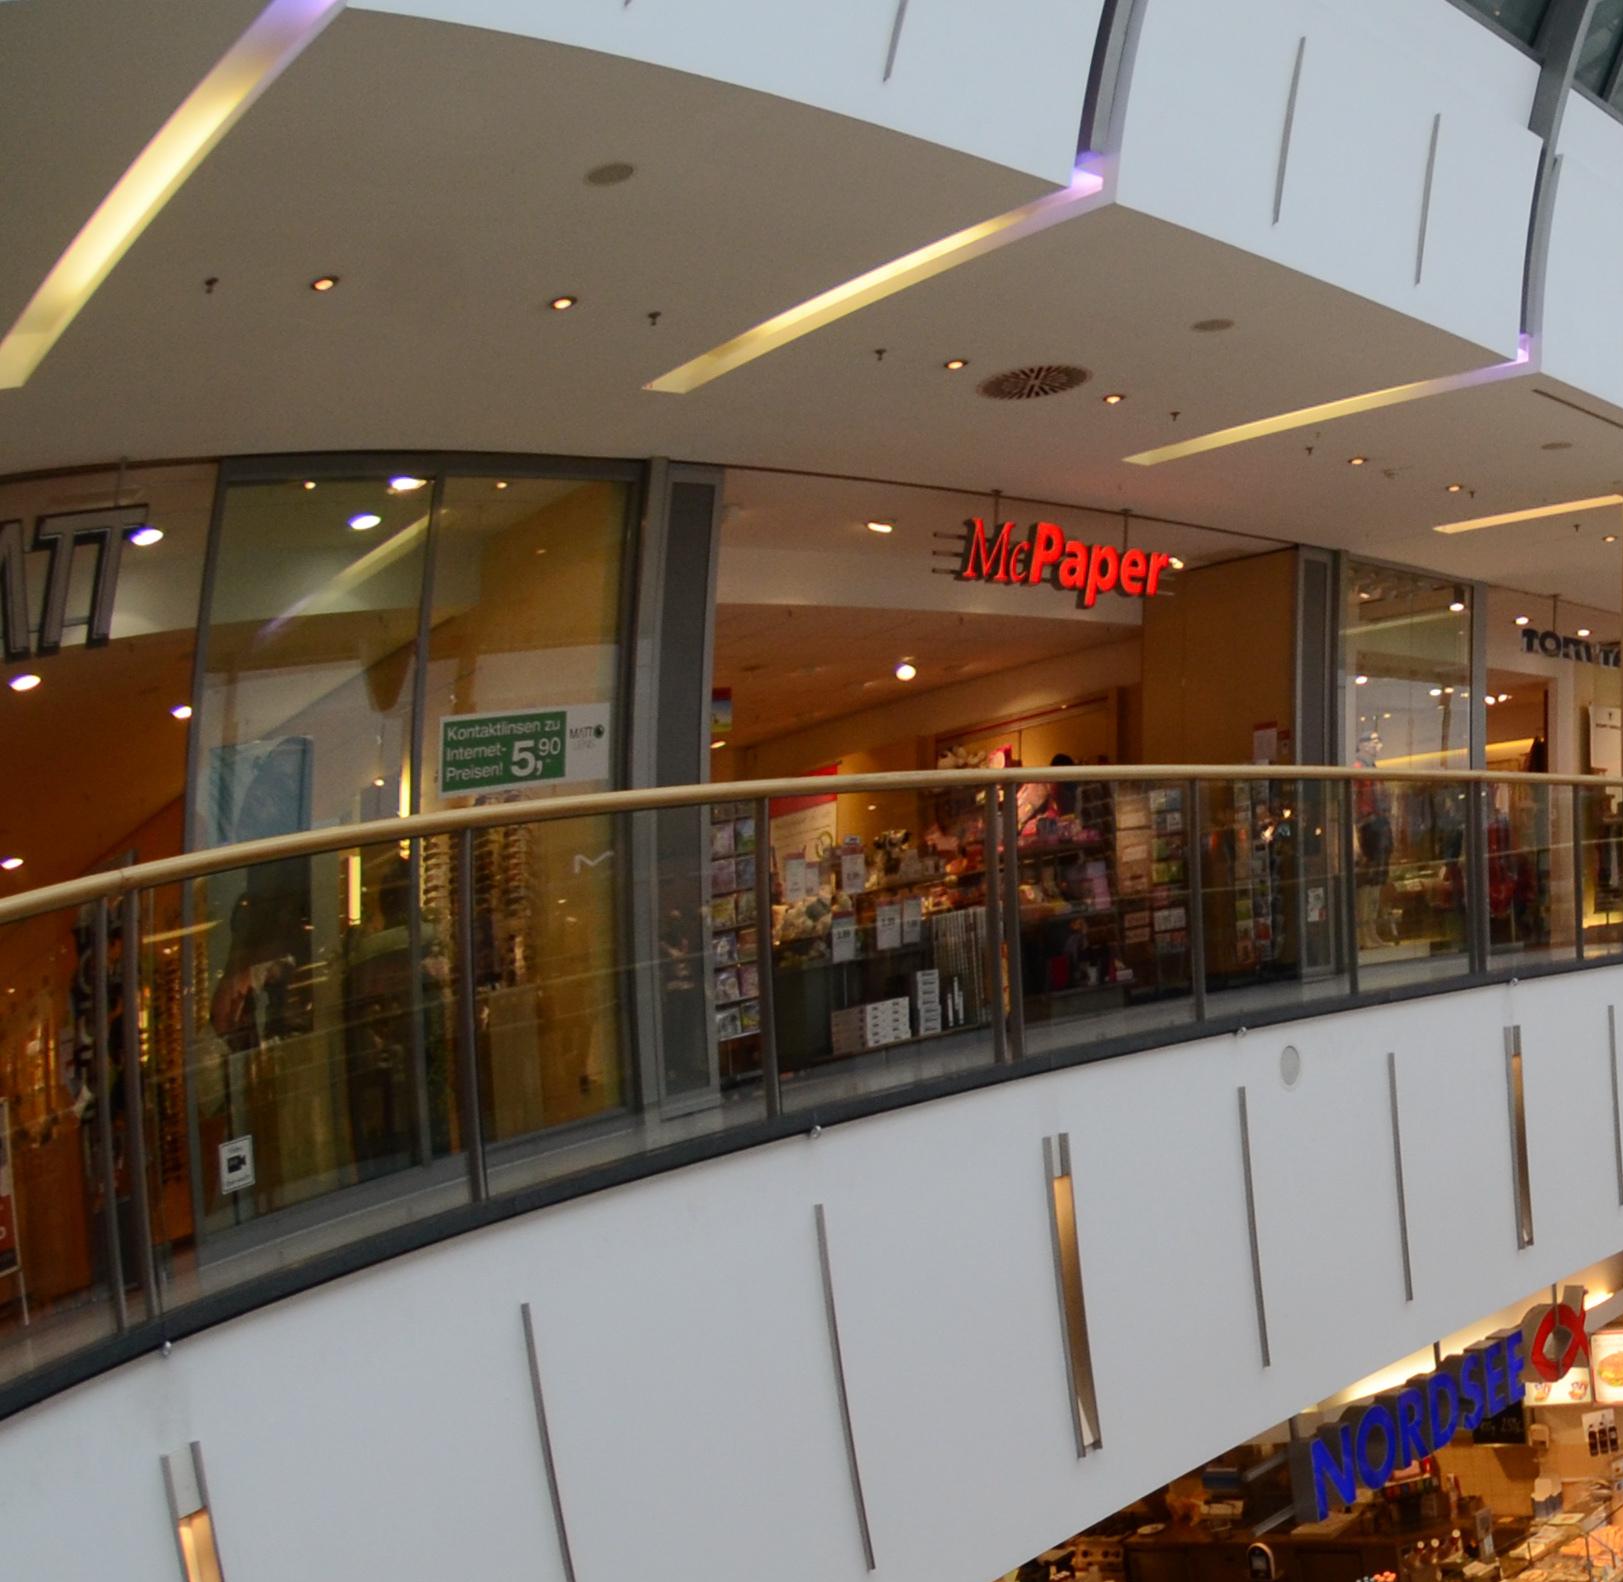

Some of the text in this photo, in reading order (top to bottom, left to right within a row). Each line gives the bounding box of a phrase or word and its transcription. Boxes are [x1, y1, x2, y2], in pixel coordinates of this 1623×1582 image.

[963, 517, 1169, 607] McPaper
[447, 719, 561, 741] Kontaktlinsen zu
[446, 743, 507, 761] Internet-
[445, 763, 504, 782] Preisen!
[1310, 1330, 1526, 1521] NORDSEE
